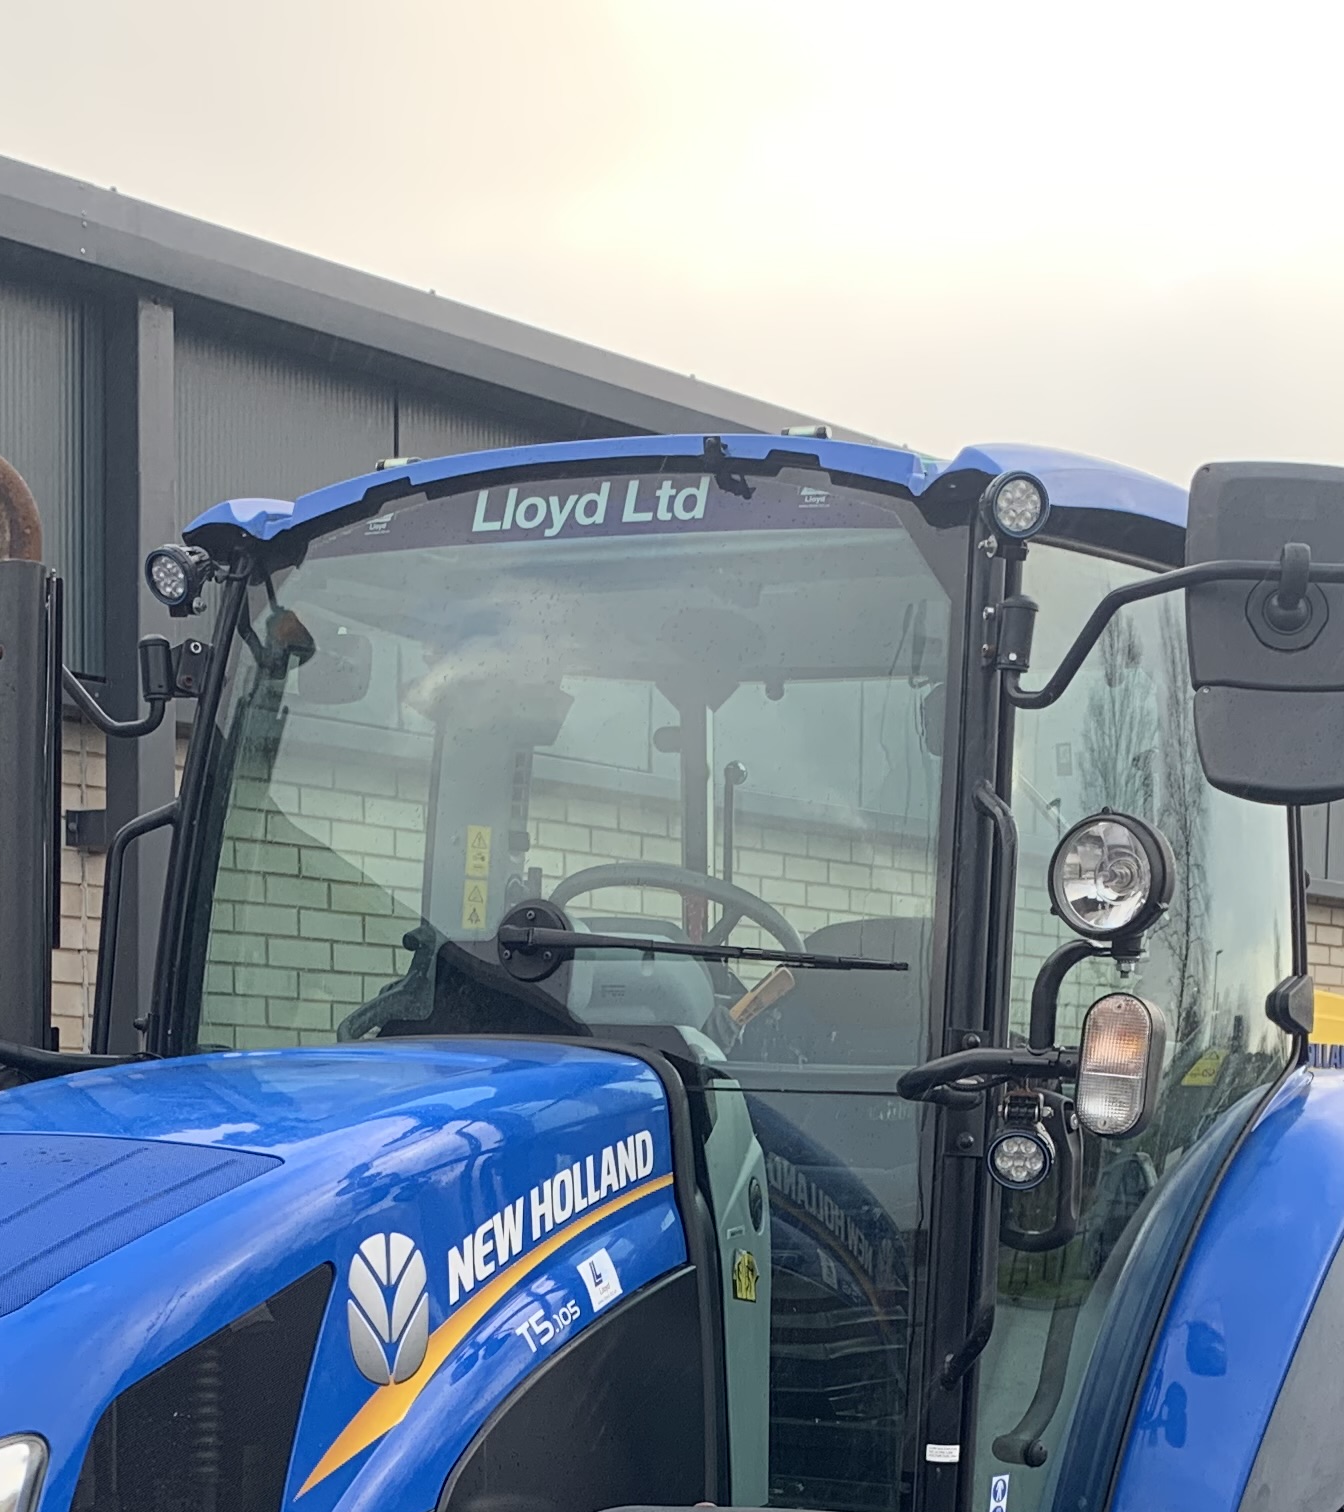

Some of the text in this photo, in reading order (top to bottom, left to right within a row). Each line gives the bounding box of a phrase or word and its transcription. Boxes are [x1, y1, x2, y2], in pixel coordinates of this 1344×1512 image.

[472, 476, 711, 537] Lloyd Ltd
[448, 1130, 654, 1306] NEW HOLLAND
